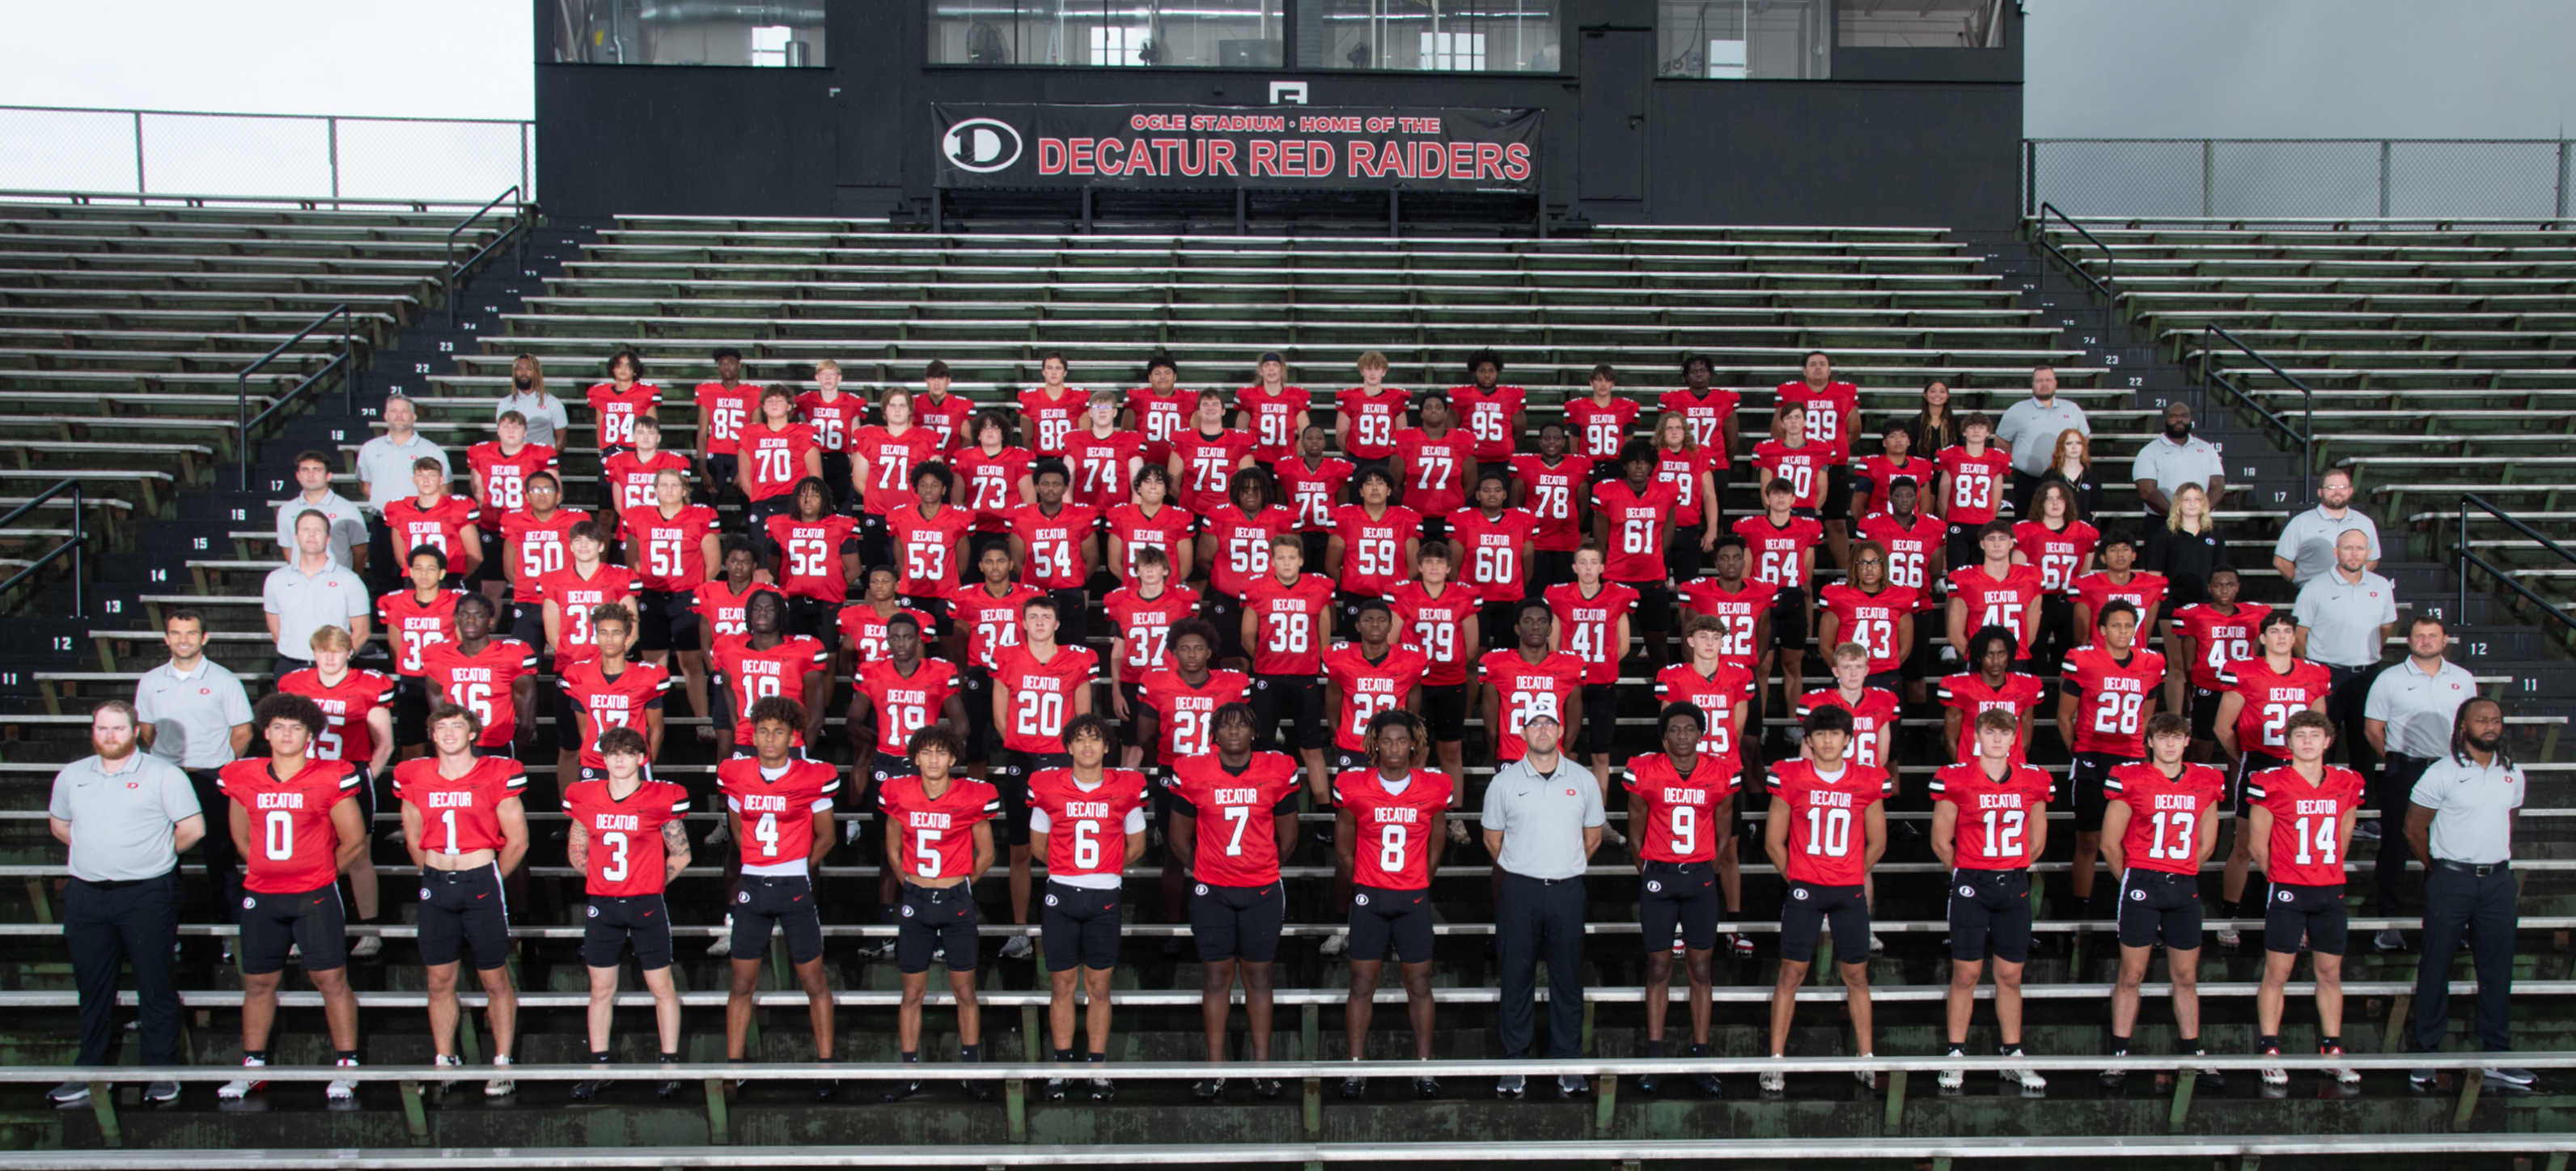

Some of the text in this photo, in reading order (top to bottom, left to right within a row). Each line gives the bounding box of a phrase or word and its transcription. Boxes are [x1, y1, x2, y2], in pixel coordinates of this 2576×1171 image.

[1130, 114, 1442, 134] OGLE STADIUM HOME OF THE
[1038, 137, 1532, 181] DECATUR RED RAIDERS
[439, 342, 454, 352] 23
[2105, 354, 2119, 365] 23
[415, 363, 430, 373] 22
[2129, 376, 2142, 387] 22
[608, 402, 633, 413] DECATUR
[717, 398, 743, 409] DECATUR
[1150, 402, 1177, 411] DECATUR
[1261, 404, 1287, 414] DECATUR
[1363, 404, 1388, 414] DECATUR
[1472, 402, 1500, 412] DECATUR
[1808, 401, 1833, 409] DECATUR
[2154, 398, 2168, 407] 21
[815, 408, 840, 418] DECATUR
[924, 414, 949, 425] DECATUR
[1041, 409, 1066, 419] DECATUR
[1591, 414, 1616, 423] DECATUR
[1688, 408, 1714, 417] DECATUR
[605, 414, 634, 443] 84
[714, 409, 745, 440] 85
[1147, 412, 1180, 441] 90
[1260, 414, 1286, 445] 91
[1360, 414, 1390, 446] 93
[1472, 412, 1502, 440] 95
[1803, 410, 1837, 442] 99
[760, 439, 788, 448] DECATUR
[1587, 425, 1618, 455] 96
[881, 444, 909, 456] DECATUR
[1087, 448, 1114, 457] DECATUR
[1197, 447, 1226, 457] DECATUR
[1422, 446, 1450, 456] DECATUR
[490, 465, 522, 475] DECATUR
[756, 448, 791, 482] 70
[977, 465, 1004, 477] DECATUR
[1663, 461, 1689, 471] DECATUR
[1960, 464, 1989, 474] DECATUR
[879, 456, 908, 490] 71
[1084, 459, 1116, 493] 74
[1193, 459, 1228, 491] 75
[1418, 457, 1452, 490] 77
[1540, 475, 1567, 486] DECATUR
[271, 480, 284, 491] 17
[489, 477, 523, 508] 68
[972, 477, 1006, 509] 73
[1299, 482, 1325, 491] DECATUR
[1956, 475, 1990, 507] 83
[1536, 486, 1568, 518] 78
[2274, 491, 2287, 503] 17
[1292, 493, 1328, 528] 76
[1626, 507, 1655, 518] DECATUR
[409, 522, 441, 533] DECATUR
[651, 528, 683, 540] DECATUR
[793, 528, 824, 539] DECATUR
[1036, 528, 1066, 541] DECATUR
[1134, 529, 1163, 541] DECATUR
[1235, 527, 1265, 539] DECATUR
[1363, 528, 1392, 538] DECATUR
[193, 537, 208, 549] 15
[523, 530, 558, 541] DECATUR
[913, 530, 943, 542] DECATUR
[1481, 534, 1509, 545] DECATUR
[1625, 520, 1654, 554] 61
[1765, 539, 1794, 549] DECATUR
[1892, 540, 1921, 552] DECATUR
[2045, 542, 2074, 554] DECATUR
[523, 542, 563, 577] 50
[650, 541, 683, 576] 51
[789, 539, 827, 576] 52
[908, 543, 945, 579] 53
[1032, 541, 1071, 577] 54
[1231, 540, 1269, 572] 56
[1359, 539, 1396, 575] 59
[1476, 547, 1513, 583] 60
[1762, 552, 1799, 587] 64
[1888, 553, 1924, 588] 66
[2041, 555, 2079, 589] 67
[150, 568, 167, 582] 14
[568, 591, 603, 604] DECATUR
[1273, 599, 1306, 611] DECATUR
[1985, 591, 2017, 604] DECATUR
[105, 600, 121, 613] 13
[1718, 602, 1750, 614] DECATUR
[1856, 607, 1888, 619] DECATUR
[981, 609, 1014, 622] DECATUR
[1133, 612, 1166, 625] DECATUR
[1419, 609, 1451, 621] DECATUR
[1573, 609, 1606, 621] DECATUR
[405, 617, 440, 630] DECATUR
[1269, 613, 1308, 652] 38
[1852, 620, 1891, 658] 43
[2212, 626, 2245, 638] DECATUR
[53, 636, 72, 651] 12
[978, 623, 1019, 663] 34
[1129, 626, 1170, 666] 37
[1416, 622, 1454, 661] 39
[1572, 623, 1605, 662] 41
[2471, 643, 2487, 656] 12
[451, 668, 491, 682] DECATUR
[743, 660, 781, 676] DECATUR
[2, 672, 17, 685] 11
[1023, 675, 1060, 691] DECATUR
[1358, 678, 1393, 692] DECATUR
[1517, 676, 1553, 689] DECATUR
[2104, 677, 2141, 692] DECATUR
[2524, 678, 2537, 691] 11
[591, 694, 629, 709] DECATUR
[888, 689, 926, 704] DECATUR
[1693, 694, 1727, 708] DECATUR
[2270, 688, 2305, 702] DECATUR
[1175, 697, 1213, 711] DECATUR
[1018, 690, 1063, 736] 20
[2095, 692, 2143, 734] 28
[888, 705, 925, 745] 19
[1174, 711, 1211, 753] 21
[257, 792, 303, 808] DECATUR
[429, 791, 472, 808] DECATUR
[1215, 788, 1256, 804] DECATUR
[1664, 787, 1705, 804] DECATUR
[1810, 790, 1851, 808] DECATUR
[1980, 794, 2021, 808] DECATUR
[2155, 795, 2195, 810] DECATUR
[744, 795, 786, 812] DECATUR
[1066, 801, 1108, 817] DECATUR
[2296, 800, 2337, 814] DECATUR
[910, 812, 951, 829] DECATUR
[1375, 807, 1417, 822] DECATUR
[596, 814, 638, 831] DECATUR
[1671, 806, 1695, 854] 9
[266, 811, 293, 860] 0
[441, 809, 460, 855] 1
[756, 812, 778, 856] 4
[1225, 806, 1248, 855] 7
[1807, 808, 1851, 856] 10
[1983, 811, 2024, 856] 12
[2150, 812, 2194, 859] 13
[1075, 820, 1099, 868] 6
[2295, 817, 2336, 864] 14
[917, 829, 942, 878] 5
[1380, 825, 1406, 872] 8
[604, 832, 628, 881] 3
